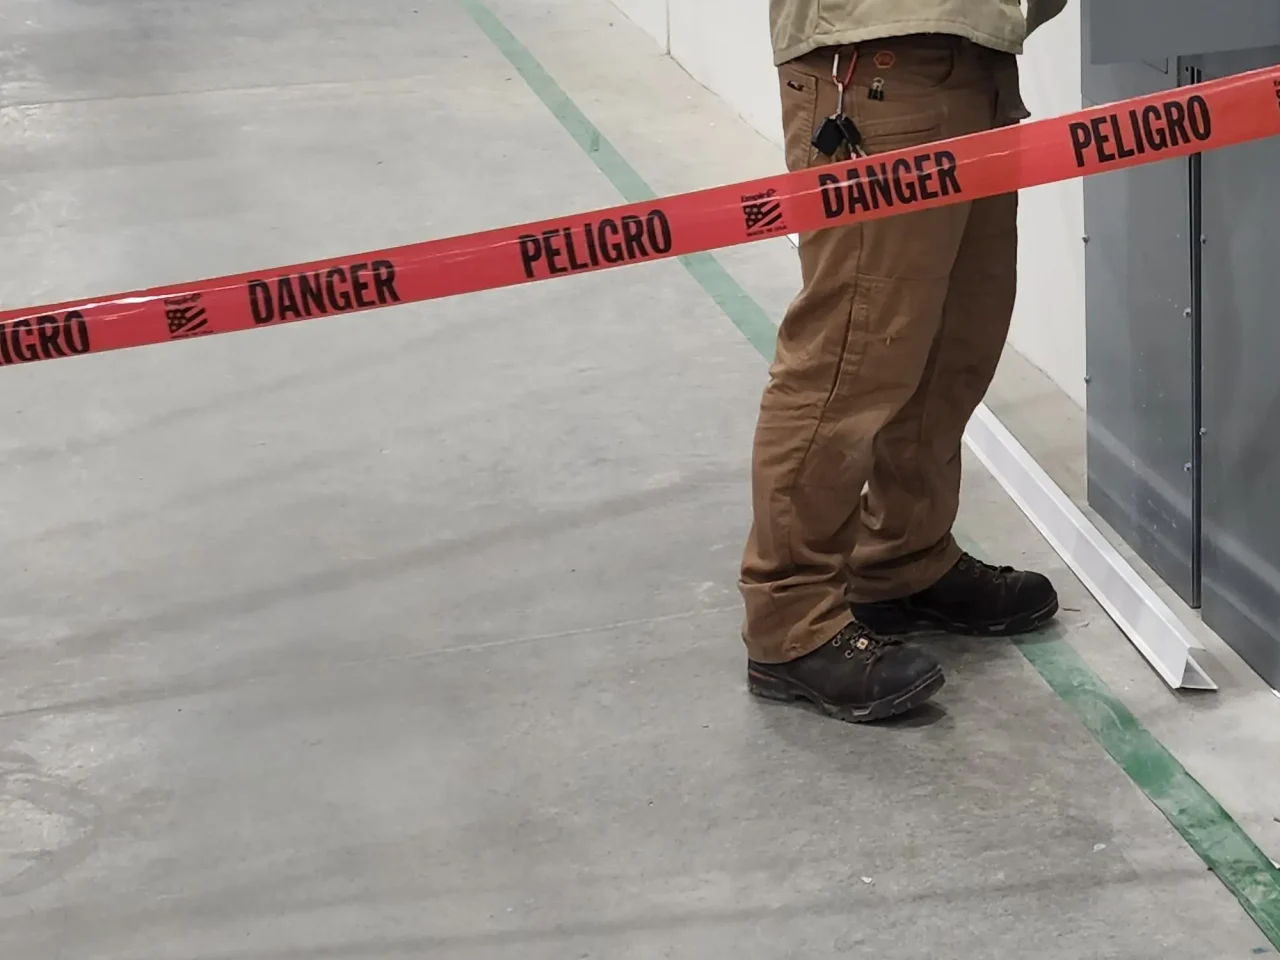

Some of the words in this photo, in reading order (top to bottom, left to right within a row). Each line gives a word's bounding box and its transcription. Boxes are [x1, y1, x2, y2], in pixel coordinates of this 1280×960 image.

[0, 309, 90, 365] IGRO
[247, 259, 400, 325] DANGER
[519, 209, 672, 278] PELIGRO
[817, 150, 961, 219] DANGER
[1068, 94, 1212, 167] PELIGRO
